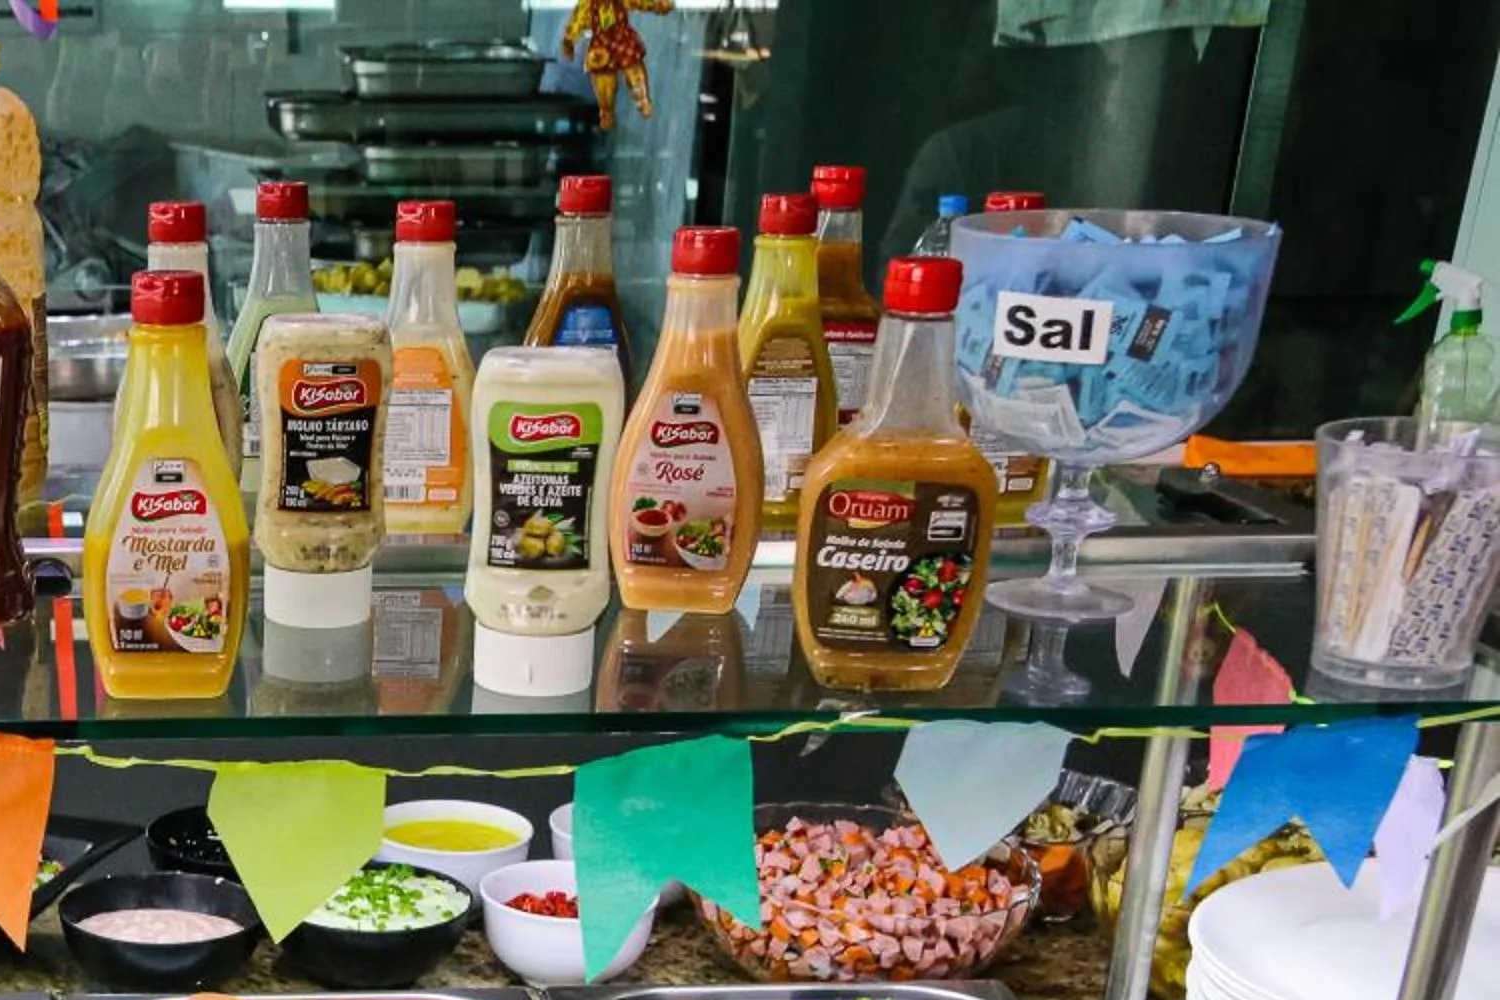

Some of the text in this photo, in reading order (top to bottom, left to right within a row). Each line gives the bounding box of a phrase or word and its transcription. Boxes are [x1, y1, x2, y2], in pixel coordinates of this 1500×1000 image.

[1003, 304, 1096, 351] Sal
[655, 460, 706, 485] Rosé
[829, 491, 909, 520] Oruam
[121, 535, 216, 557] Mostarda
[816, 545, 910, 573] Caseiro
[133, 553, 189, 574] e Mel
